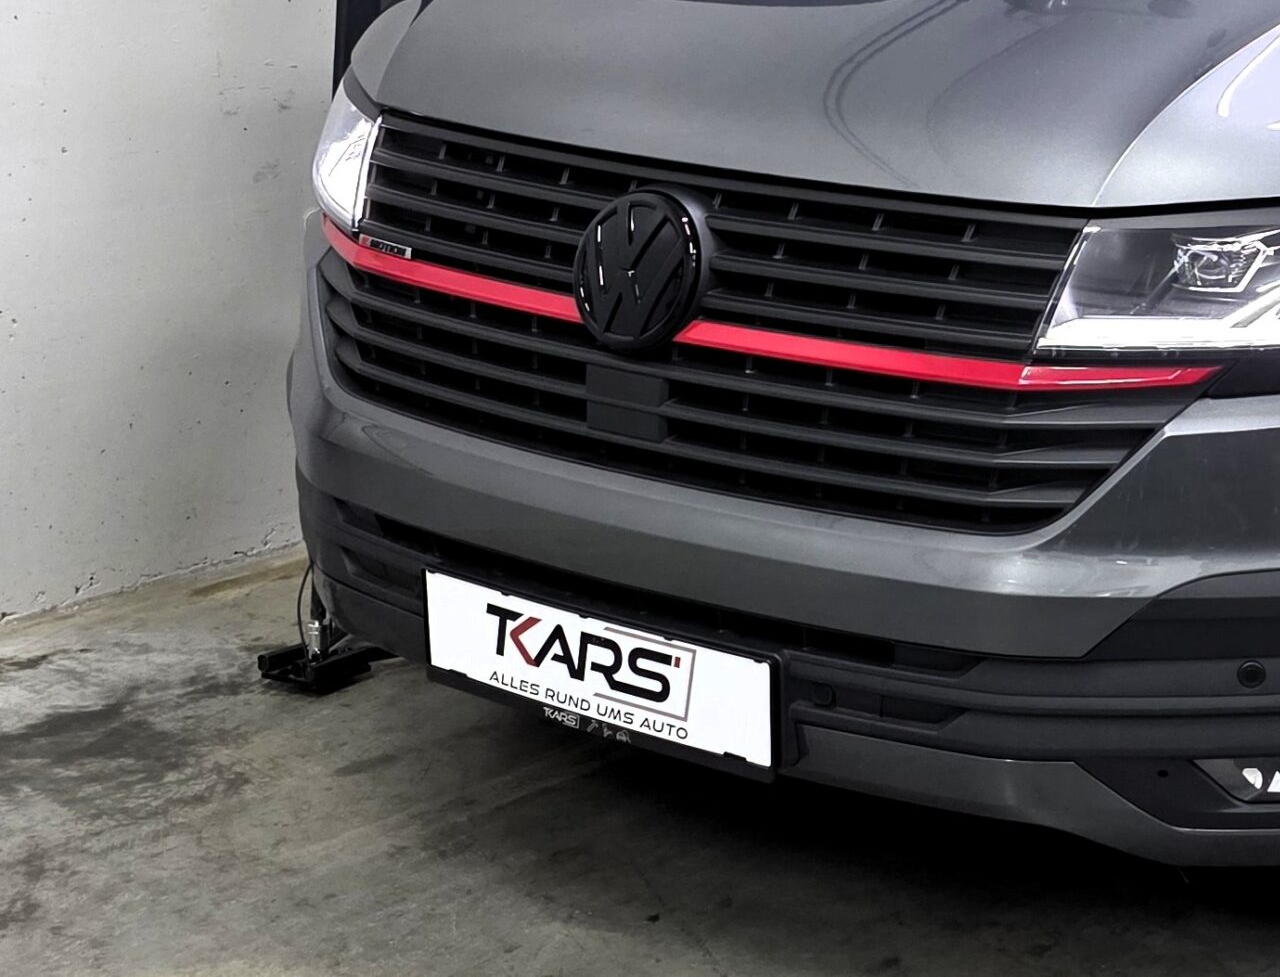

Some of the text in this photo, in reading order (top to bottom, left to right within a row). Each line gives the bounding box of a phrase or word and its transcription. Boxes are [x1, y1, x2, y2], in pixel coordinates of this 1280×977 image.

[489, 671, 688, 740] ALLES RUND UMS AUTO
